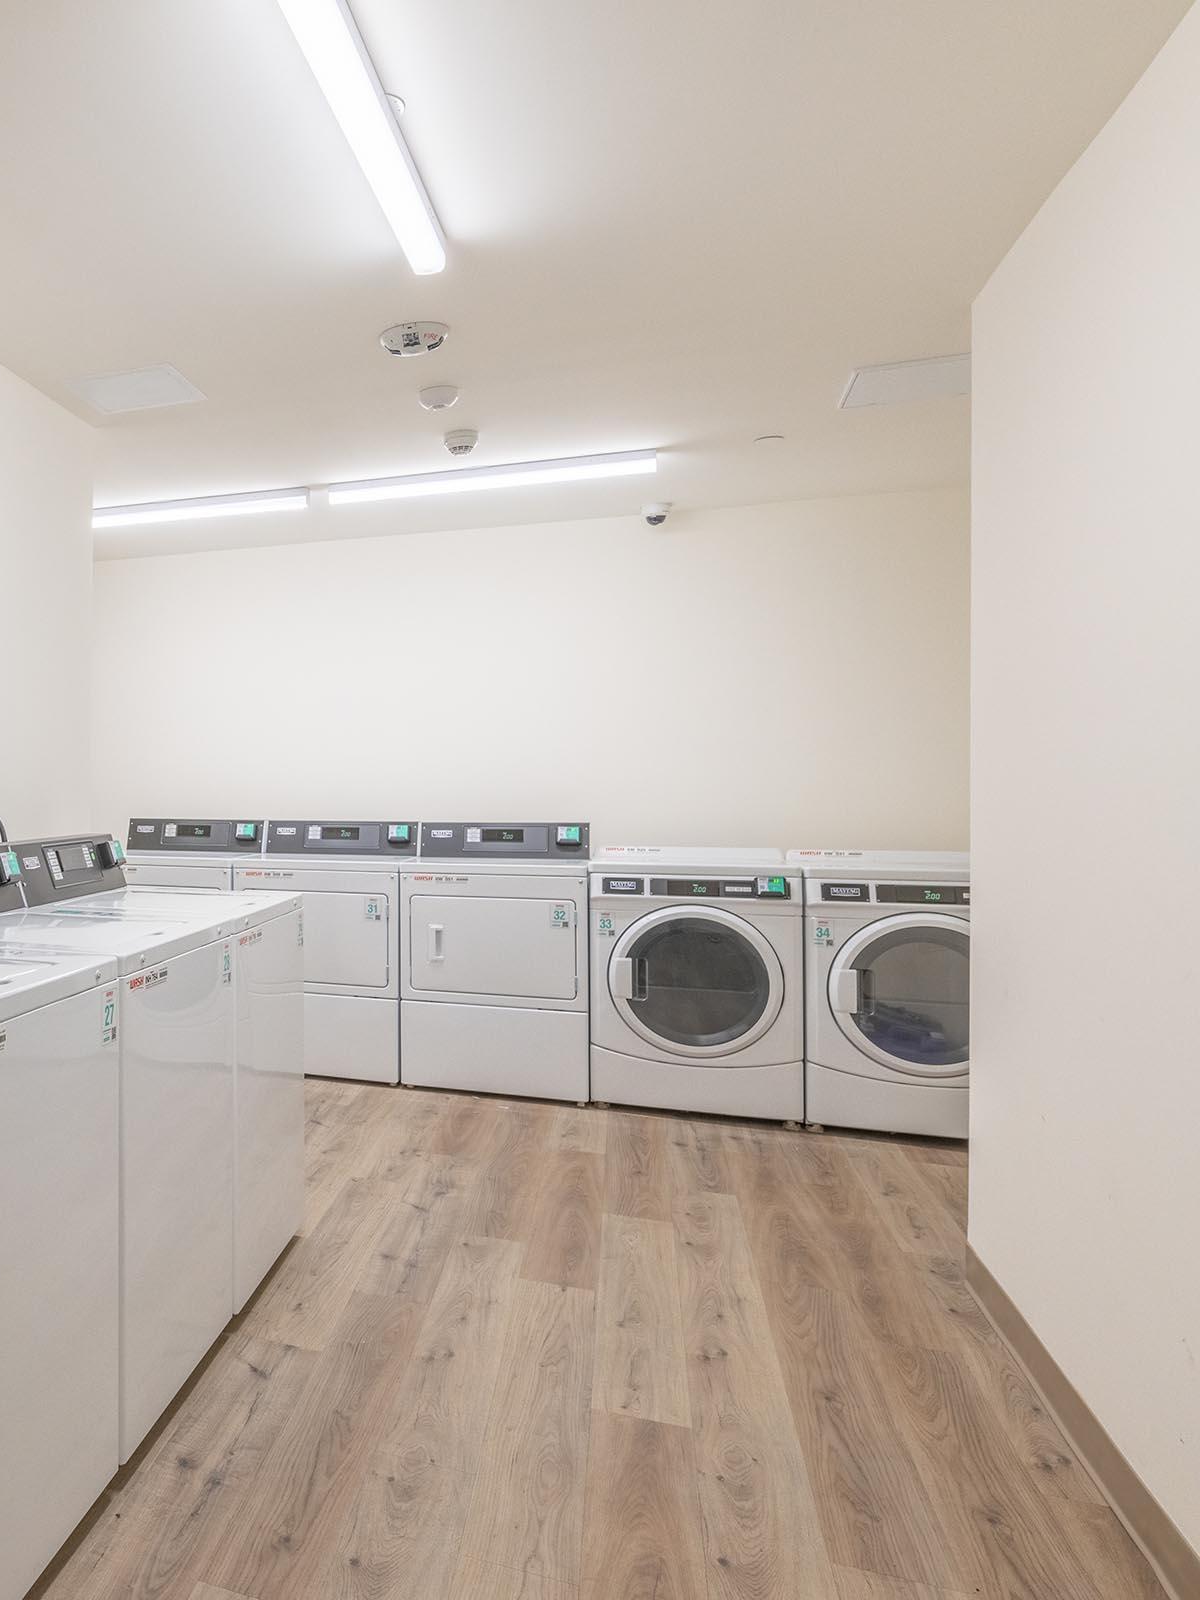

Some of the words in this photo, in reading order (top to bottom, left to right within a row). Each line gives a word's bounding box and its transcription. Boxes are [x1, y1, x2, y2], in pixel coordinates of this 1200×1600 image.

[367, 904, 377, 913] 31
[554, 911, 565, 920] 32
[600, 919, 611, 928] 33
[816, 927, 830, 938] 34
[105, 1004, 114, 1026] 27
